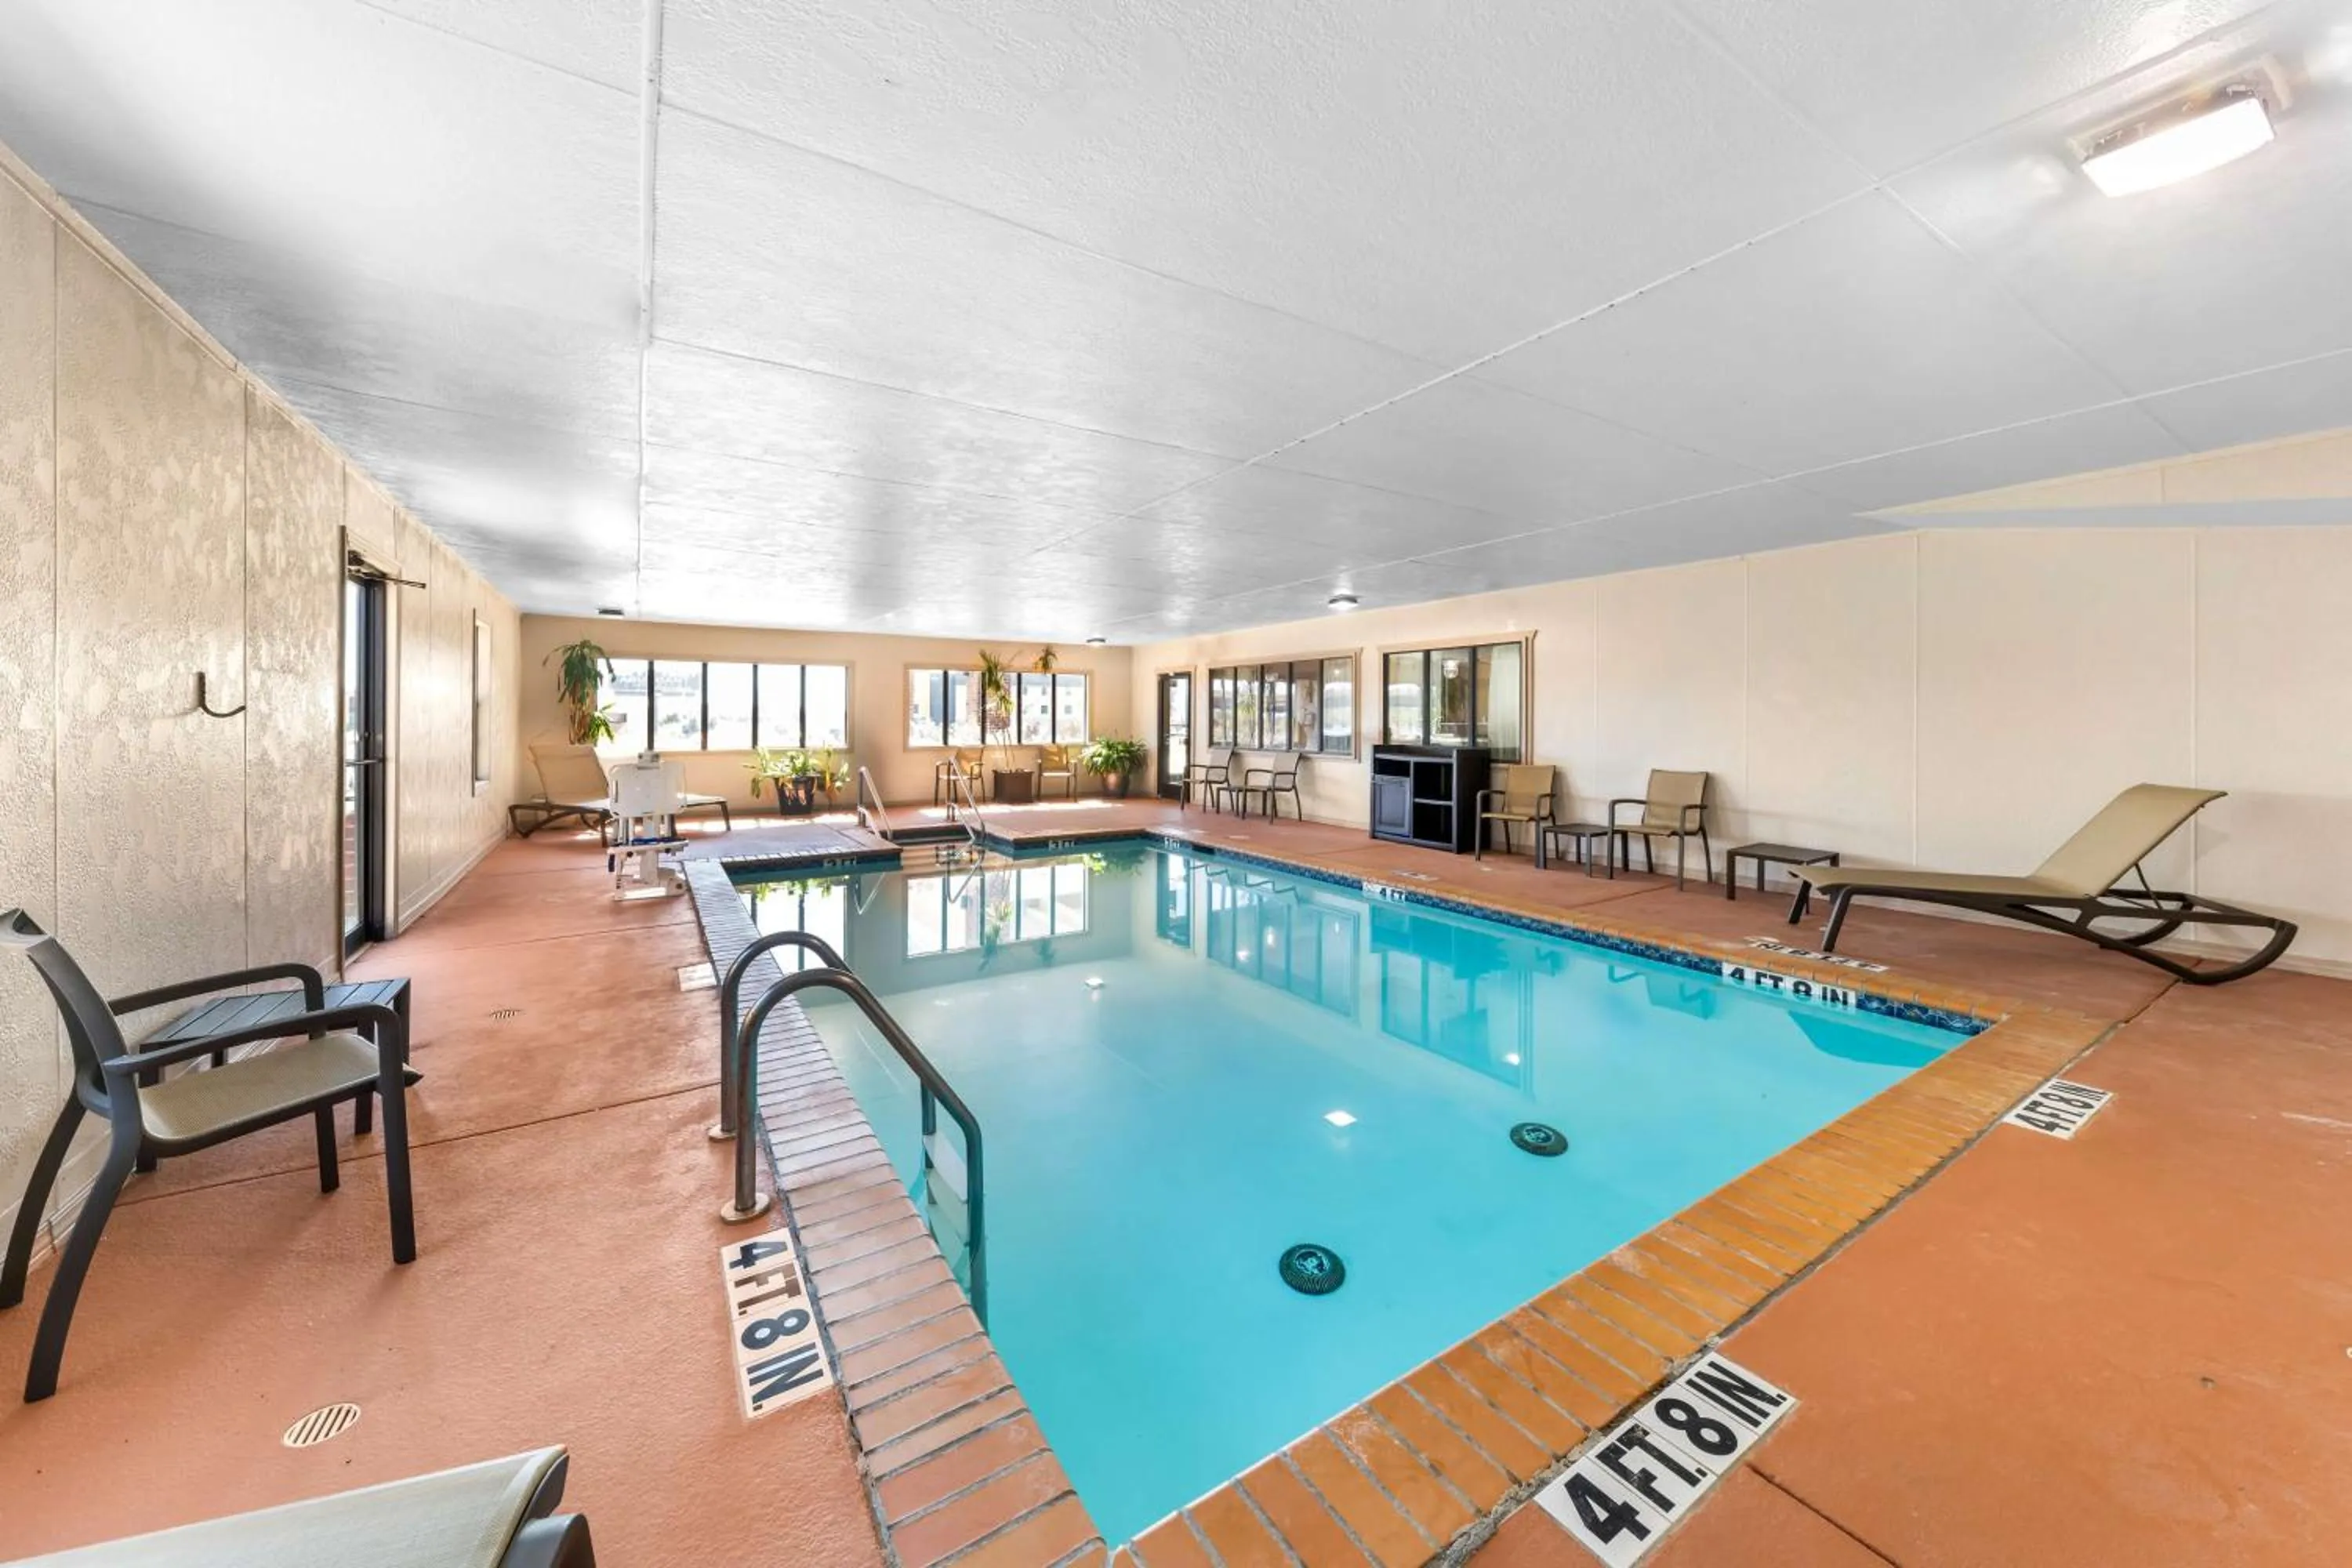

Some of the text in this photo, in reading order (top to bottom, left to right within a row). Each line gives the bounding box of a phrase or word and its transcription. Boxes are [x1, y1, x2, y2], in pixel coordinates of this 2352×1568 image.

[1730, 967, 1849, 1007] 4 FT 8 IN
[2038, 1091, 2095, 1110] 8
[2014, 1112, 2071, 1133] 4
[728, 1241, 824, 1412] 4 FT. 8 IN.
[1563, 1359, 1788, 1545] 4 FT. 8 IN.
